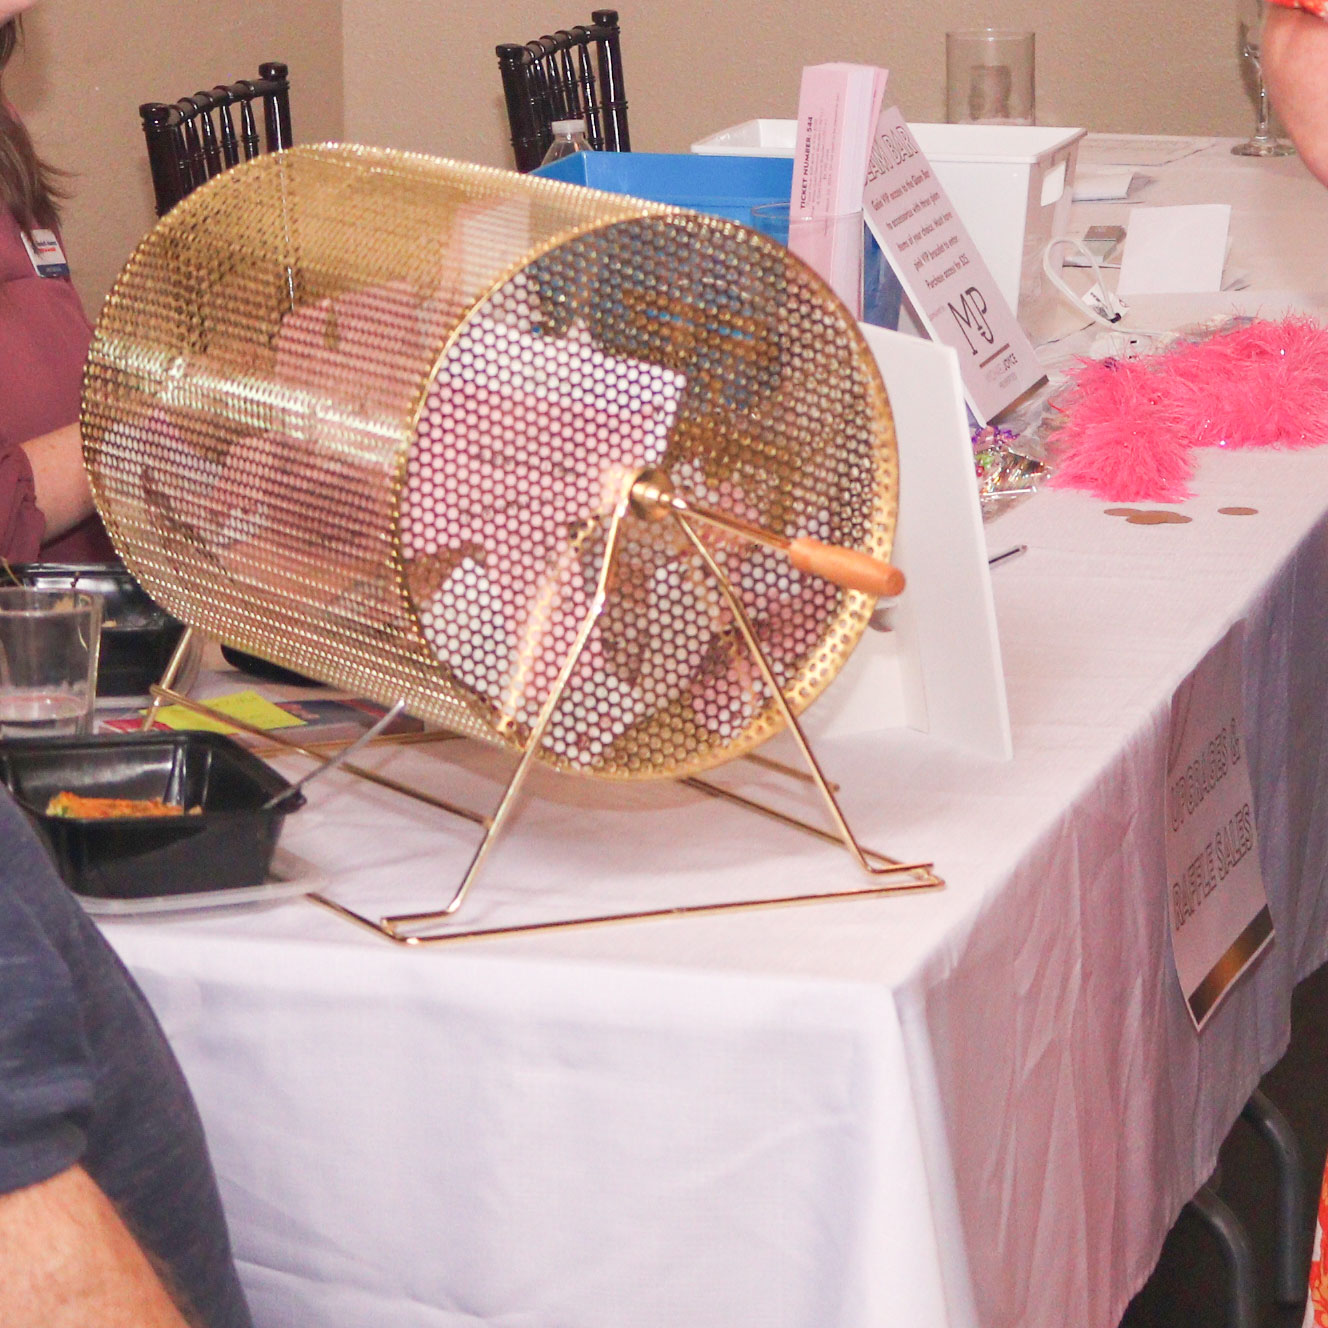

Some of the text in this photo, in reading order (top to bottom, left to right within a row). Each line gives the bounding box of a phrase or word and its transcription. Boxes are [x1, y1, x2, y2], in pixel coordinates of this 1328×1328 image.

[881, 125, 919, 166] BAR
[800, 178, 808, 209] TICKET
[1172, 802, 1253, 931] RAFFLE SALES
